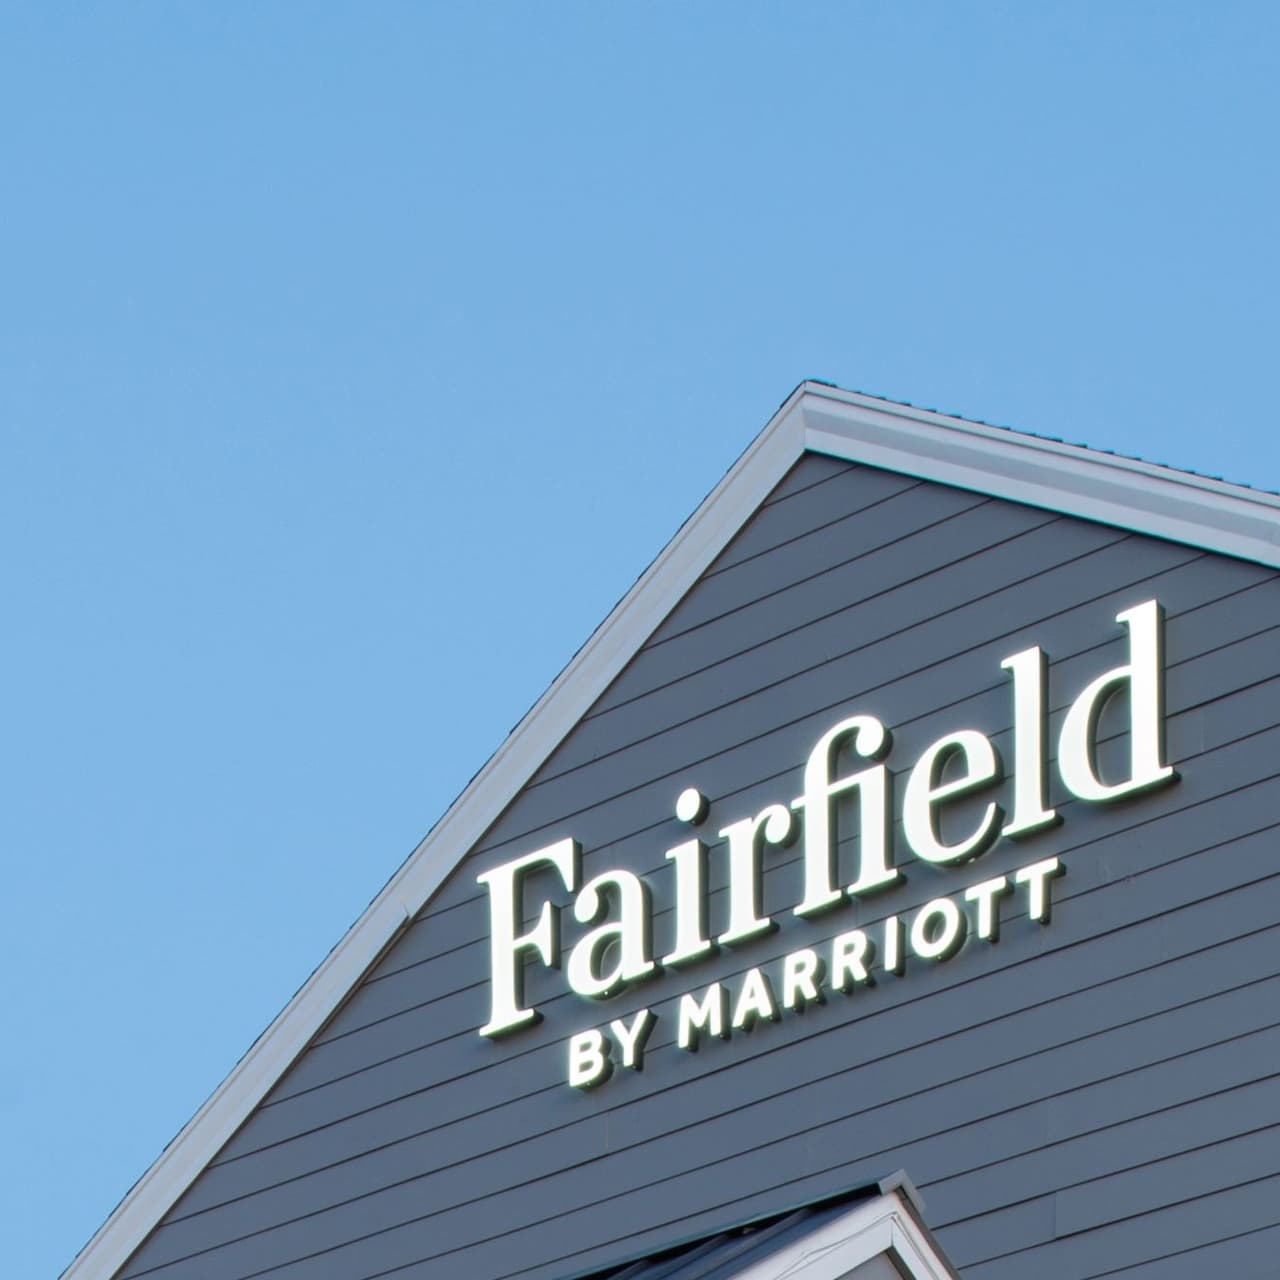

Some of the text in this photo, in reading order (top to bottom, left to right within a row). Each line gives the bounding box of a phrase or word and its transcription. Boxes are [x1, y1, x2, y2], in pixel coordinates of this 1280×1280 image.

[475, 598, 1175, 1038] Fairfield
[567, 856, 1062, 1088] BY MARRIOTT
